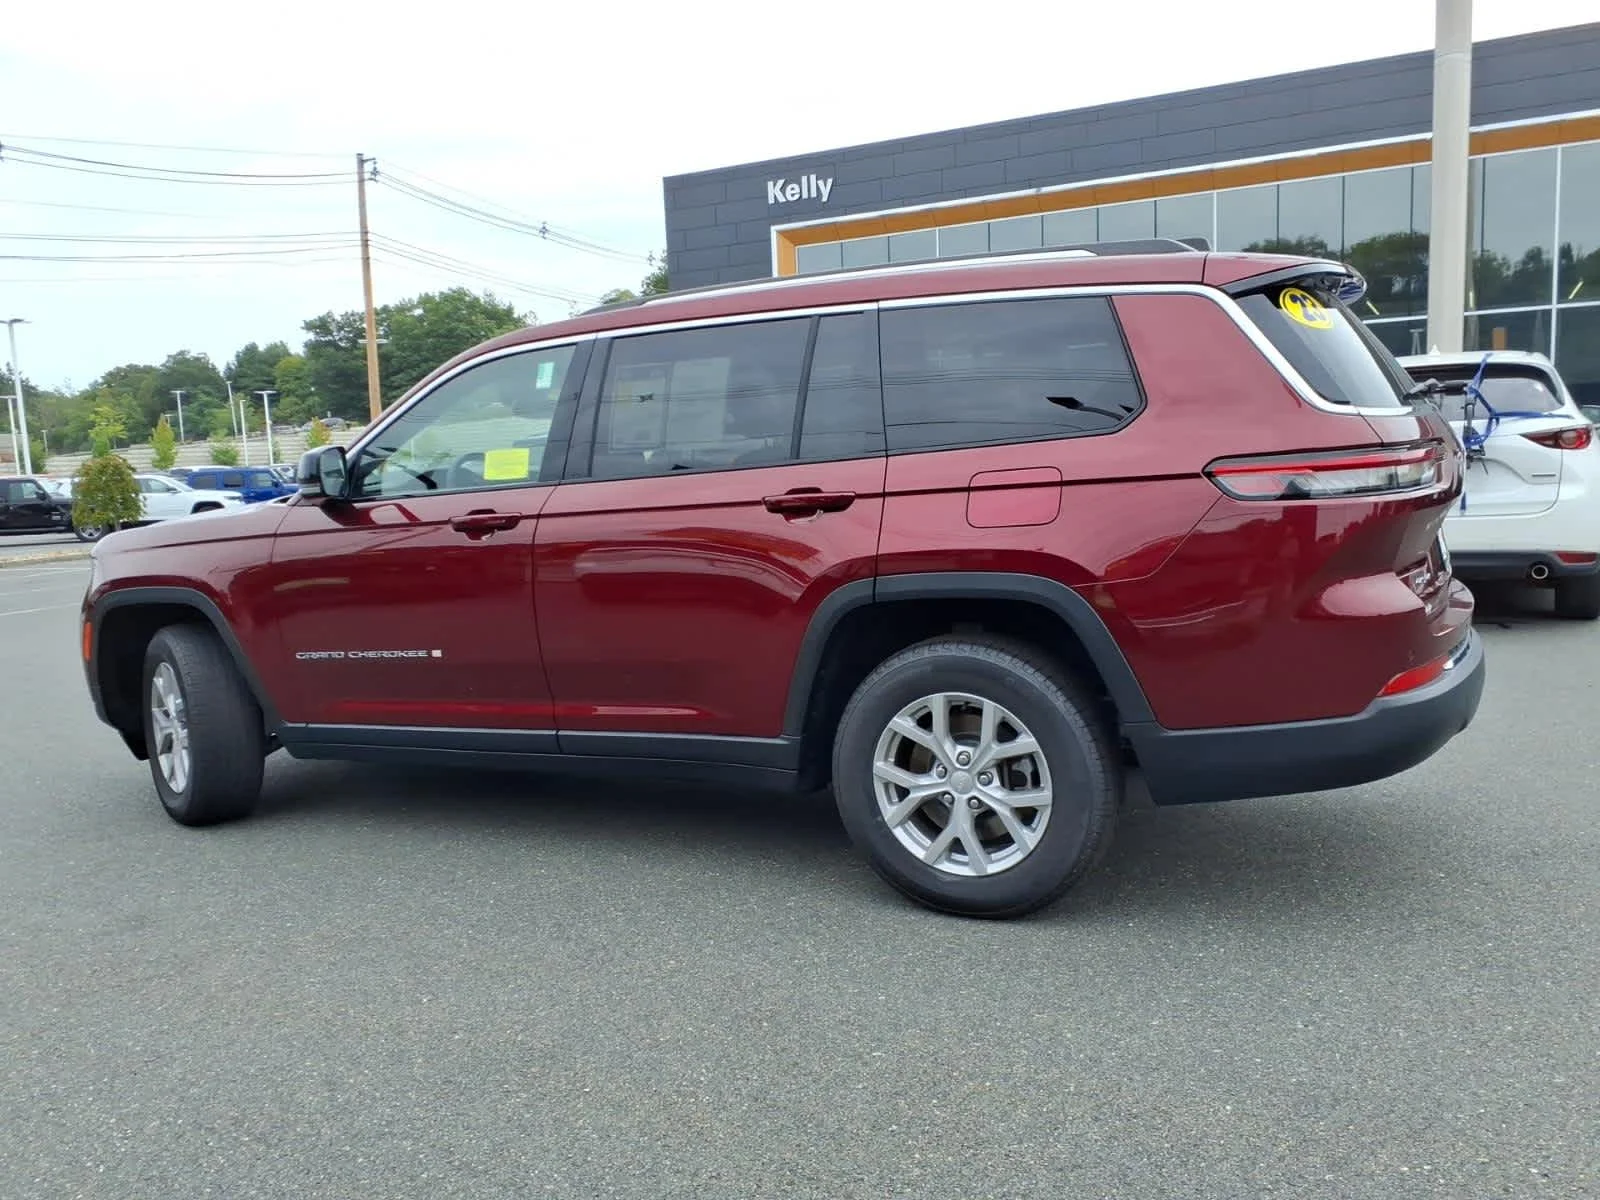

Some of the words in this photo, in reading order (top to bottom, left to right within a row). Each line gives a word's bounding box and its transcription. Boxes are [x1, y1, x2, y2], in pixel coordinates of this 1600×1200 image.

[767, 173, 833, 205] Kelly
[296, 651, 345, 659] GRAND
[348, 650, 429, 658] CHEROKEE
